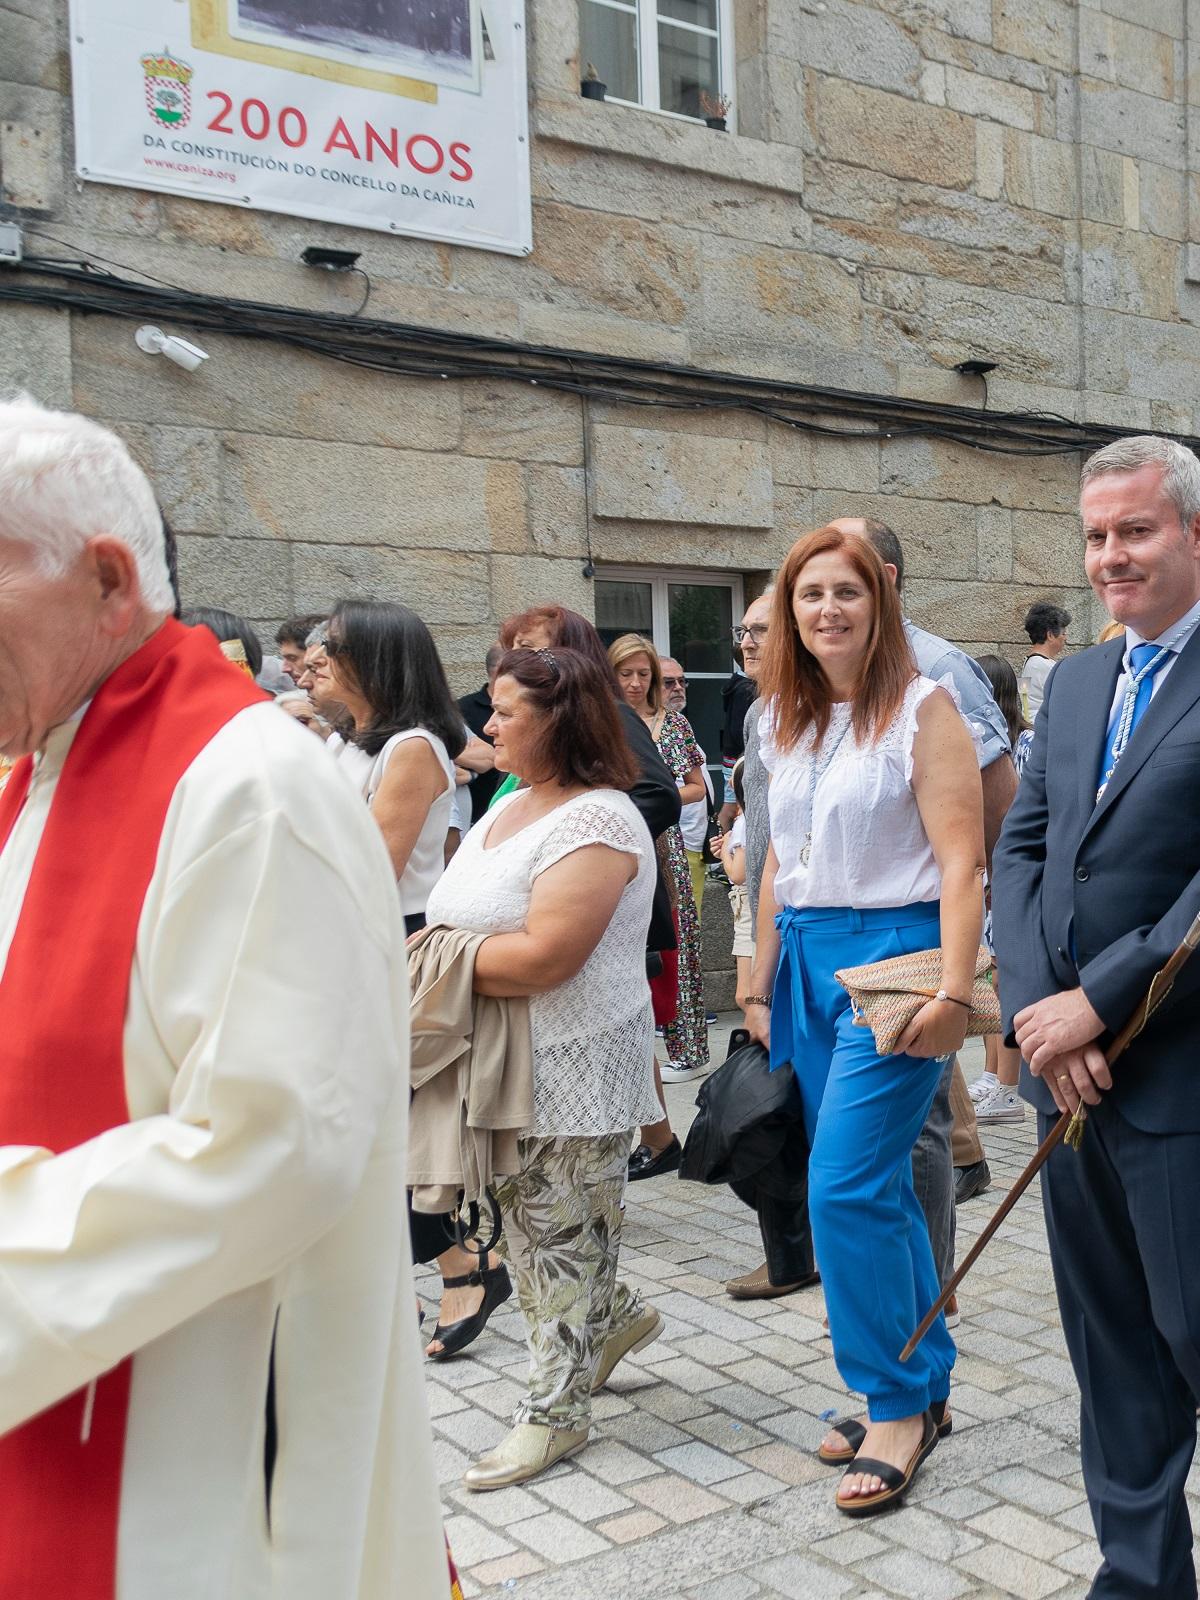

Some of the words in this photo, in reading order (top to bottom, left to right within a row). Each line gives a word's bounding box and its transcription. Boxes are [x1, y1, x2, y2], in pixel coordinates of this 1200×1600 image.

[143, 157, 236, 184] www.caniza.org
[143, 134, 166, 150] DA
[170, 140, 289, 172] CONSTITUCIÓN
[293, 163, 316, 177] DO
[320, 168, 397, 193] CONCELLO
[401, 184, 420, 199] DA
[423, 189, 475, 208] CAÑIZA
[206, 90, 308, 148] 200
[323, 115, 474, 182] ANOS
